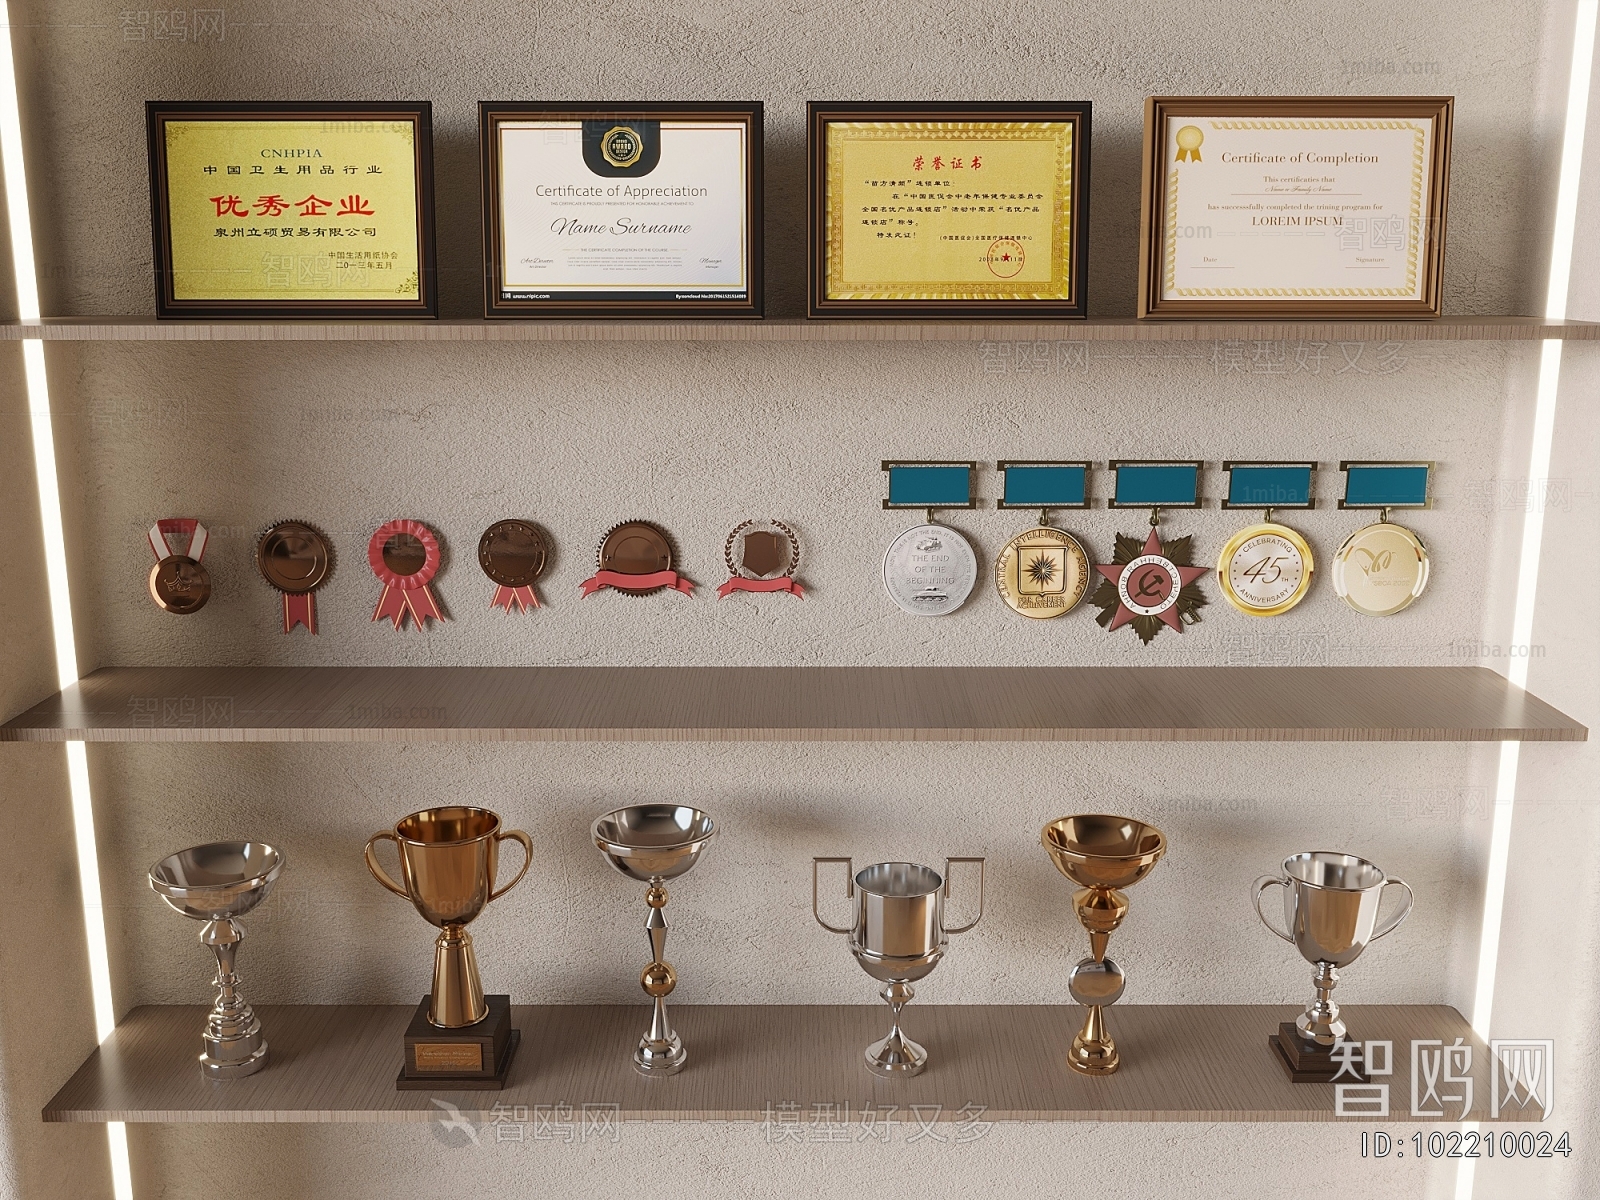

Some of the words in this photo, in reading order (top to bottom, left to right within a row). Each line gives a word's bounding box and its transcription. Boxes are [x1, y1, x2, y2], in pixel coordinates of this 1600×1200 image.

[260, 148, 323, 159] CNHPIA
[1221, 151, 1286, 164] Certificate
[1289, 151, 1304, 164] of
[1306, 151, 1379, 167] Completion
[203, 164, 383, 175] 中国卫生用品行业
[912, 154, 983, 171] 荣誉证书
[1262, 175, 1279, 183] This
[1280, 175, 1320, 183] certificaties
[535, 184, 603, 198] Certificate
[606, 184, 621, 198] of
[623, 185, 708, 200] Appreciation
[209, 194, 376, 217] 优秀企业
[1266, 203, 1302, 212] completed
[1316, 203, 1340, 212] trining
[550, 217, 608, 236] Name
[608, 217, 692, 236] Surname
[1252, 216, 1301, 226] LOREIM
[1304, 216, 1343, 226] IPSUM
[213, 227, 377, 238] 泉州立硕贸易有限公司
[1202, 255, 1218, 263] Date
[1355, 255, 1385, 264] Signature
[1009, 530, 1080, 554] INTELLIGENCE
[1242, 537, 1293, 553] CELEBRATING
[1073, 556, 1087, 599] AGENCY
[1243, 556, 1289, 584] 45
[1239, 588, 1289, 604] ANNIVERSARY
